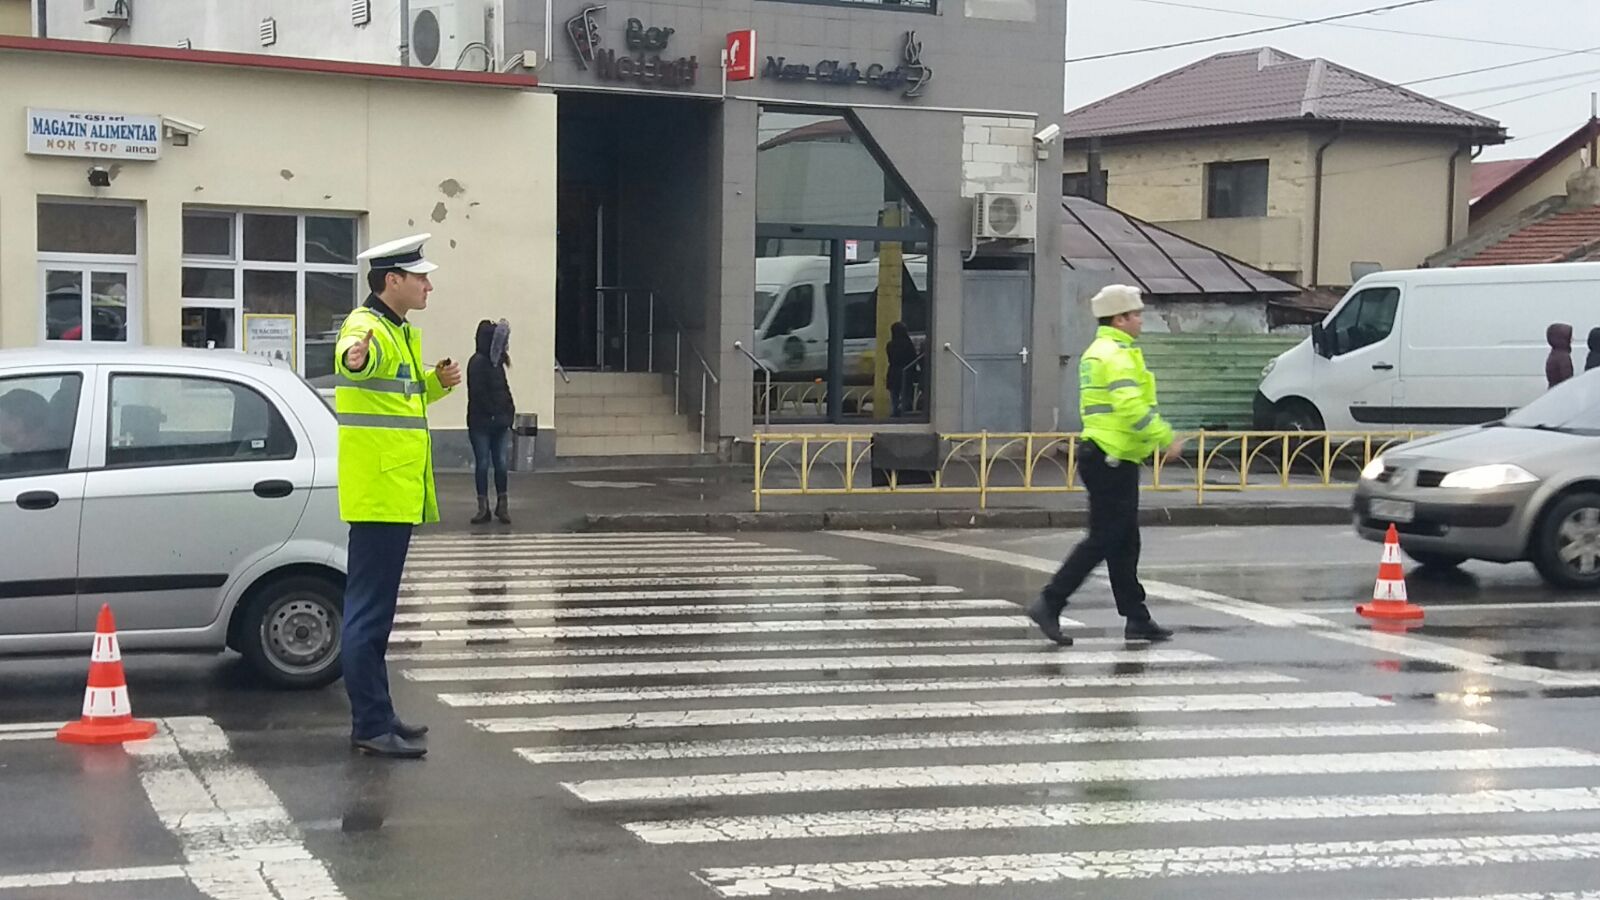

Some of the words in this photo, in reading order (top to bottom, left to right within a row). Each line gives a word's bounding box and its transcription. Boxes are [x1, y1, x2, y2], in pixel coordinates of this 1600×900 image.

[626, 17, 675, 50] Bar
[763, 56, 810, 80] New
[815, 60, 861, 83] Club
[32, 117, 87, 137] MAGAZIN
[90, 124, 157, 141] ALIMENTAR
[46, 139, 76, 151] NON
[84, 141, 117, 153] STOP
[125, 145, 157, 154] anexa
